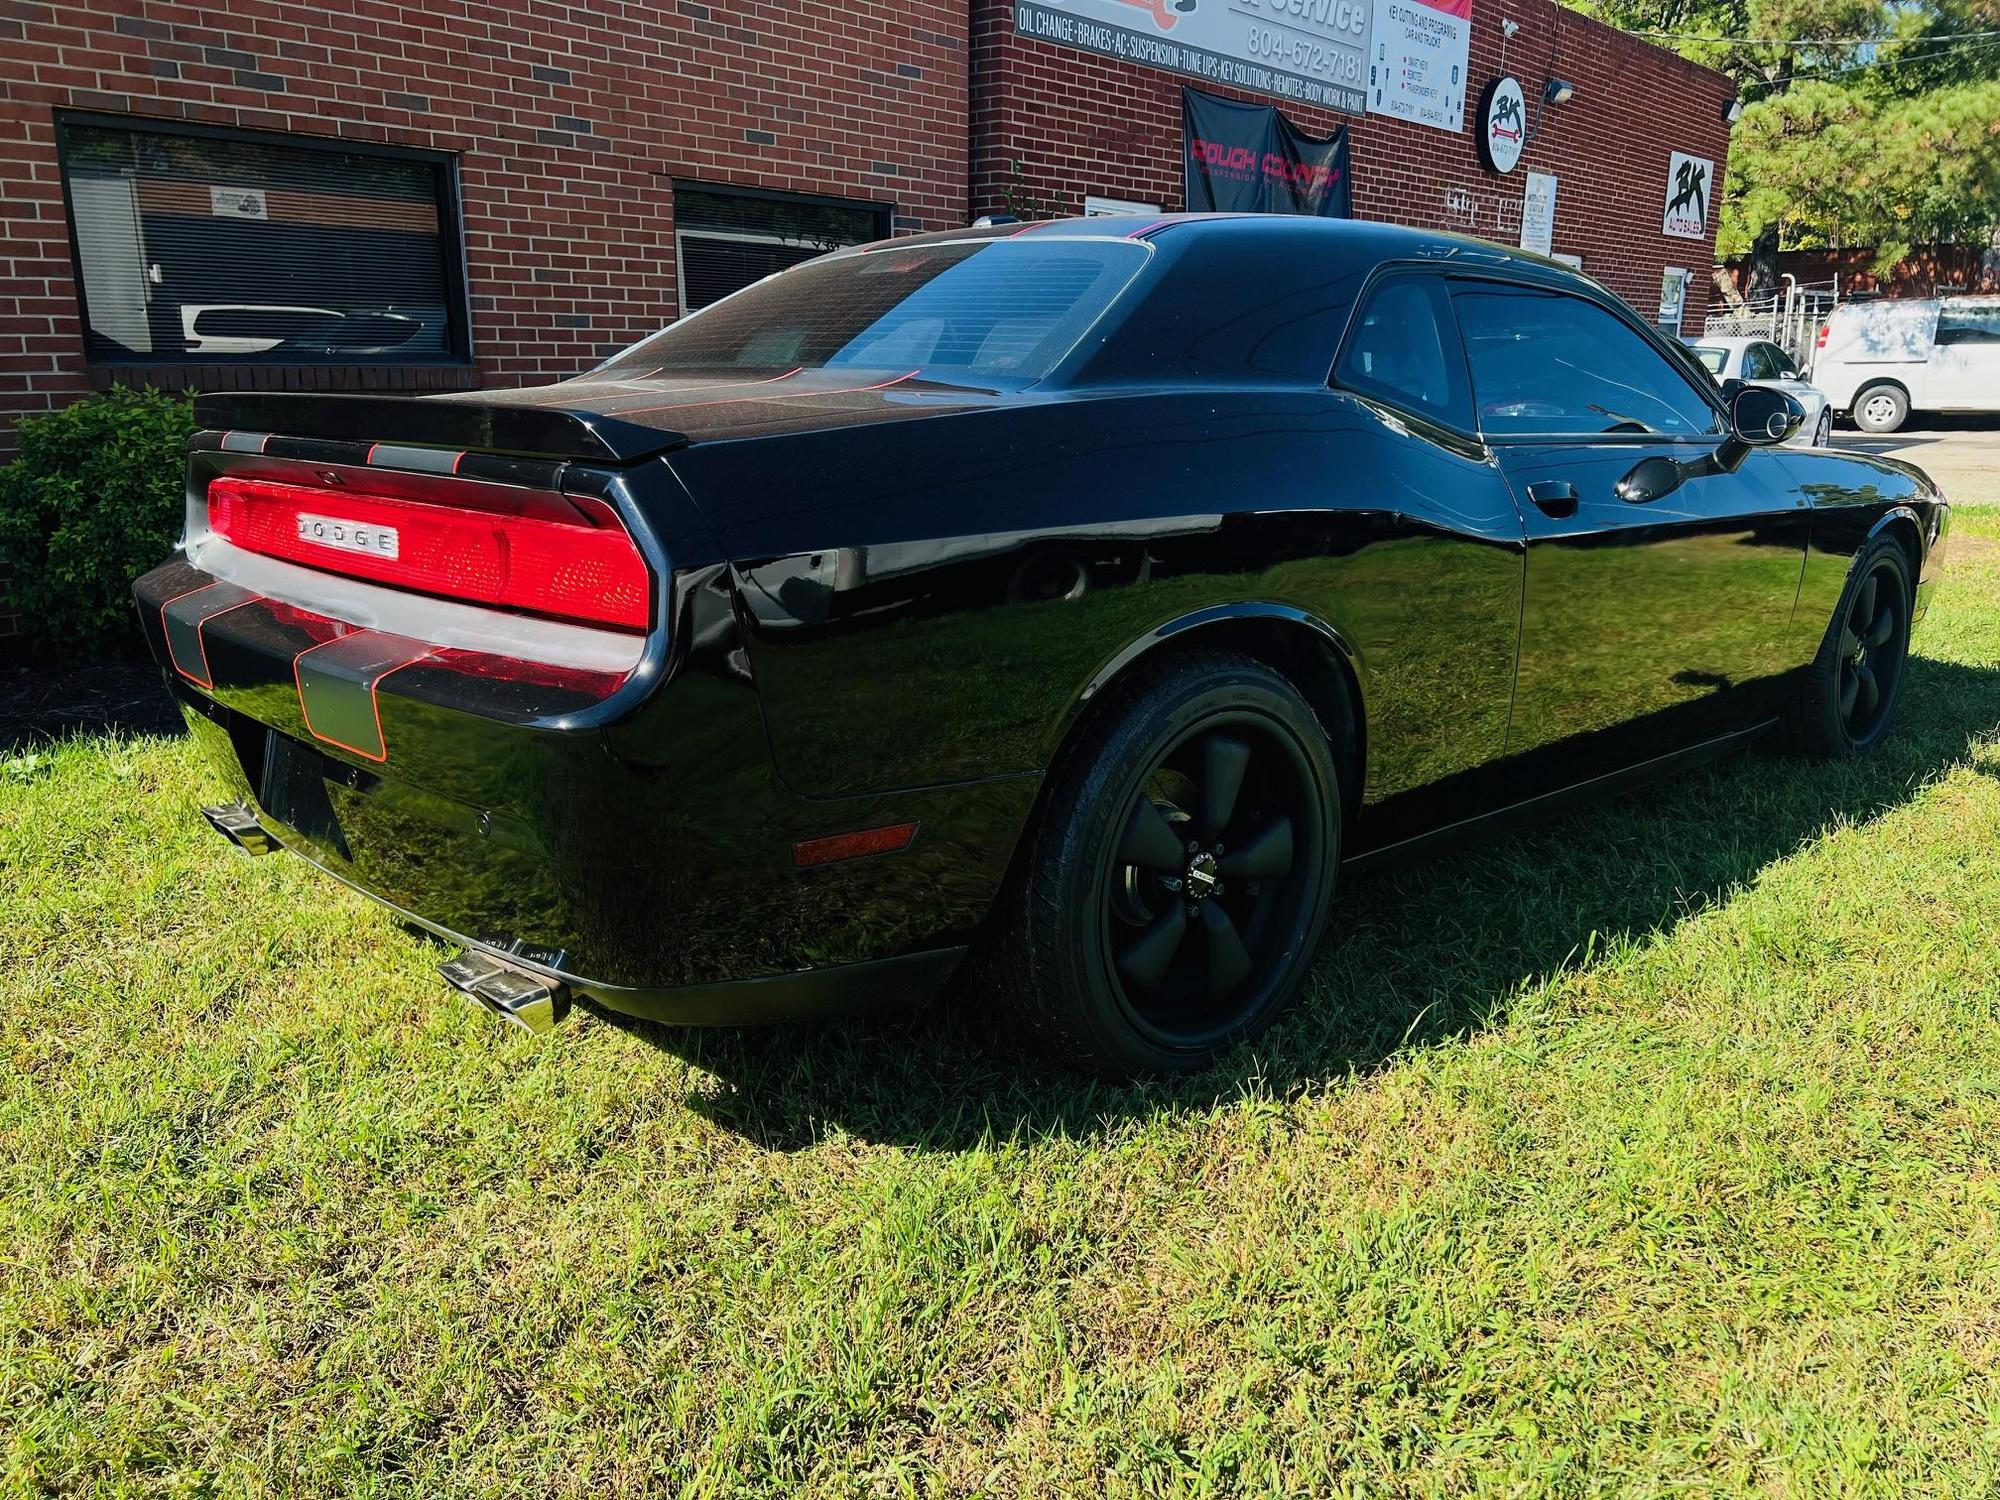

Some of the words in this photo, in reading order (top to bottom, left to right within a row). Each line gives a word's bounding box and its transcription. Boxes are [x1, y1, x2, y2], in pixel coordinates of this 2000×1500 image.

[1271, 0, 1364, 34] ervice
[1019, 7, 1034, 33] OIL
[1036, 11, 1073, 42] CHANGE
[1077, 22, 1112, 51] BRAKES
[1115, 33, 1127, 55] AC
[1130, 36, 1179, 68] SUSPENSION
[1182, 49, 1202, 74] TUNE
[1203, 55, 1218, 77] UPS
[1220, 60, 1234, 80] KEY
[1234, 63, 1272, 90] SOLUTIONS
[1274, 73, 1304, 98] REMOTES
[1305, 82, 1322, 102] BODY
[1322, 86, 1341, 108] WORK
[1346, 93, 1364, 112] PAINT
[1248, 25, 1363, 83] 804-672-7181
[1490, 95, 1522, 138] BK
[1191, 139, 1257, 171] ROUGH
[1261, 152, 1341, 188] COUNTRY
